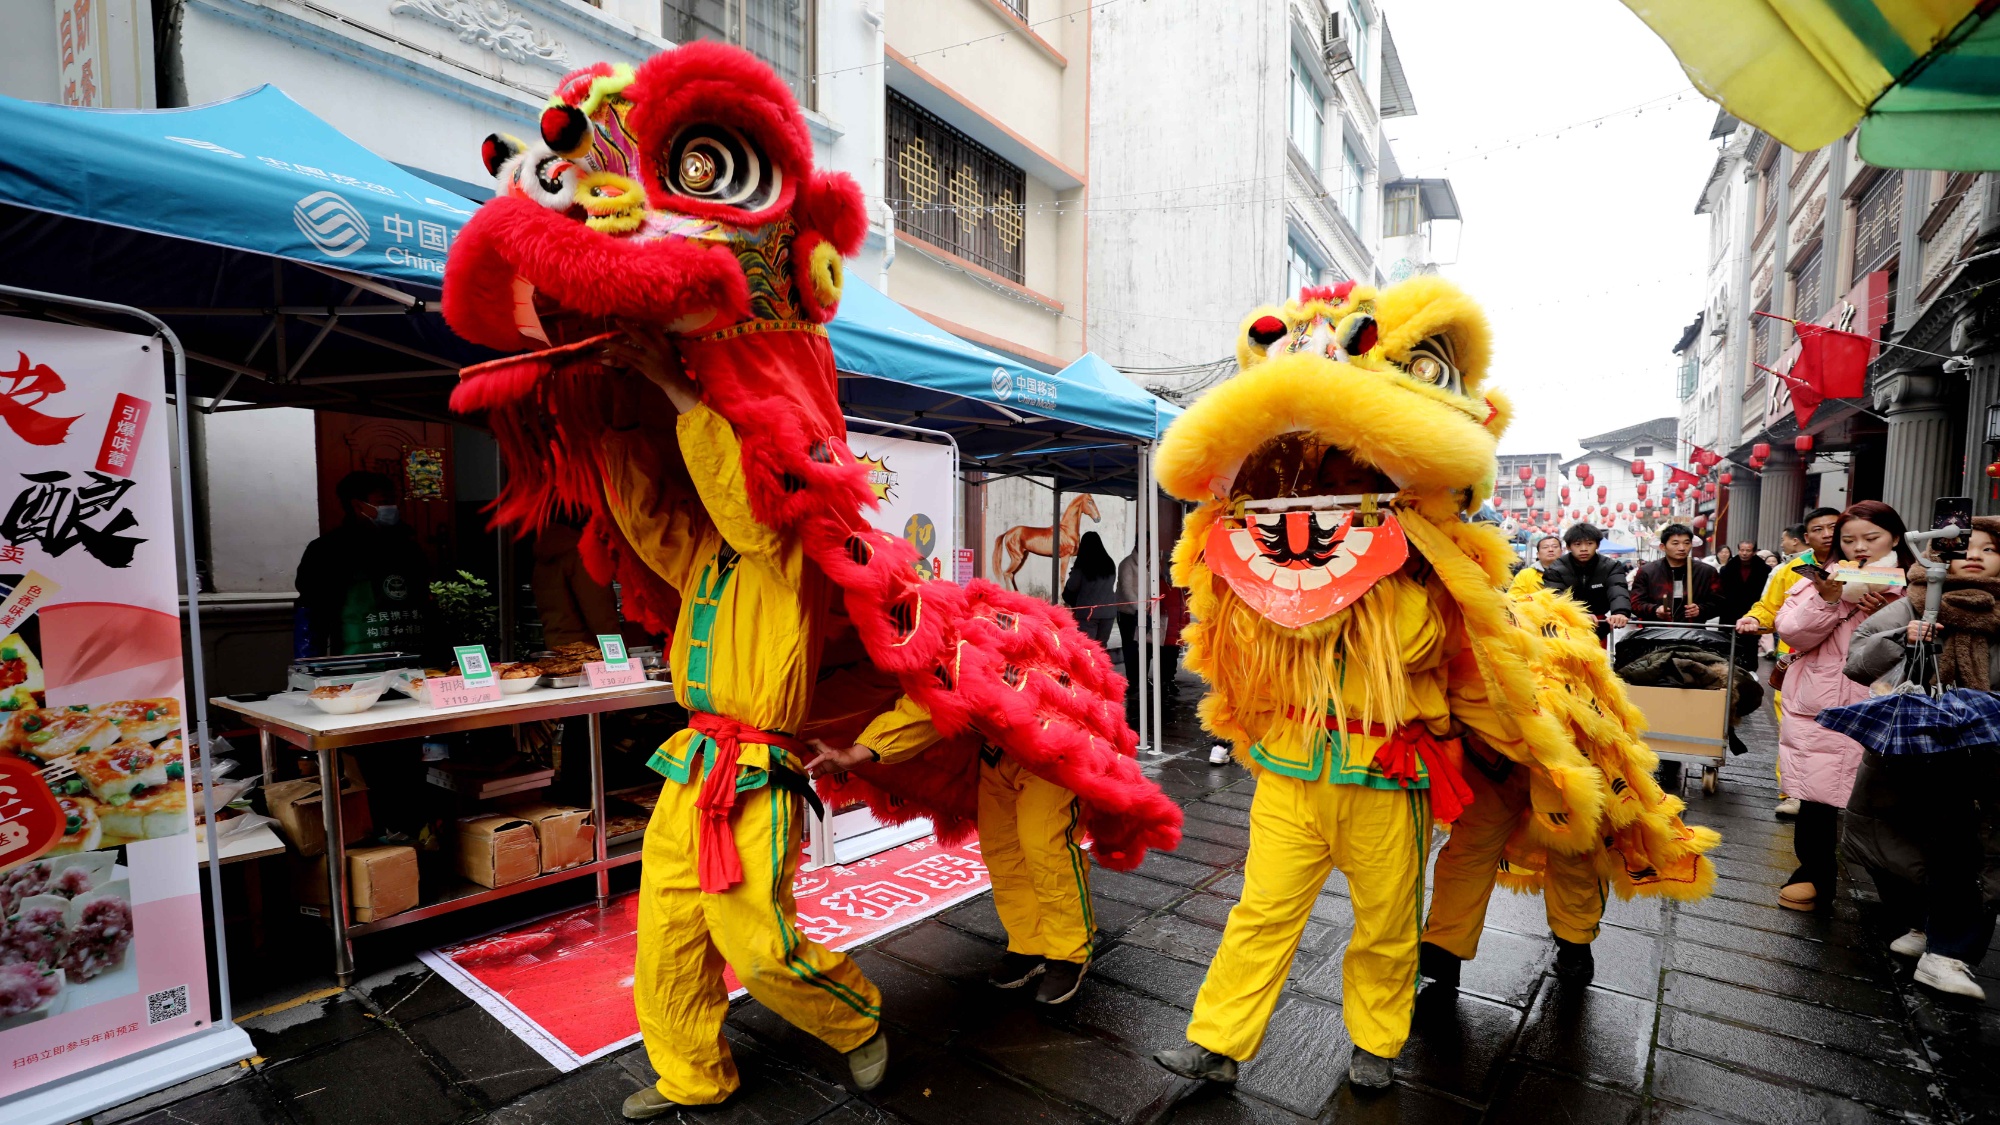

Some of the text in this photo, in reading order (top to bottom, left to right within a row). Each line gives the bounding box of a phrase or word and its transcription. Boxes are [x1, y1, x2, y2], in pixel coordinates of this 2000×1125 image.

[383, 213, 456, 252] 中国
[1016, 375, 1058, 399] 中国移动
[1017, 393, 1036, 406] China
[107, 405, 141, 468] 引爆味蕾
[0, 585, 42, 629] 色香味美
[12, 1022, 139, 1069] 扫码立即参与年前预定
